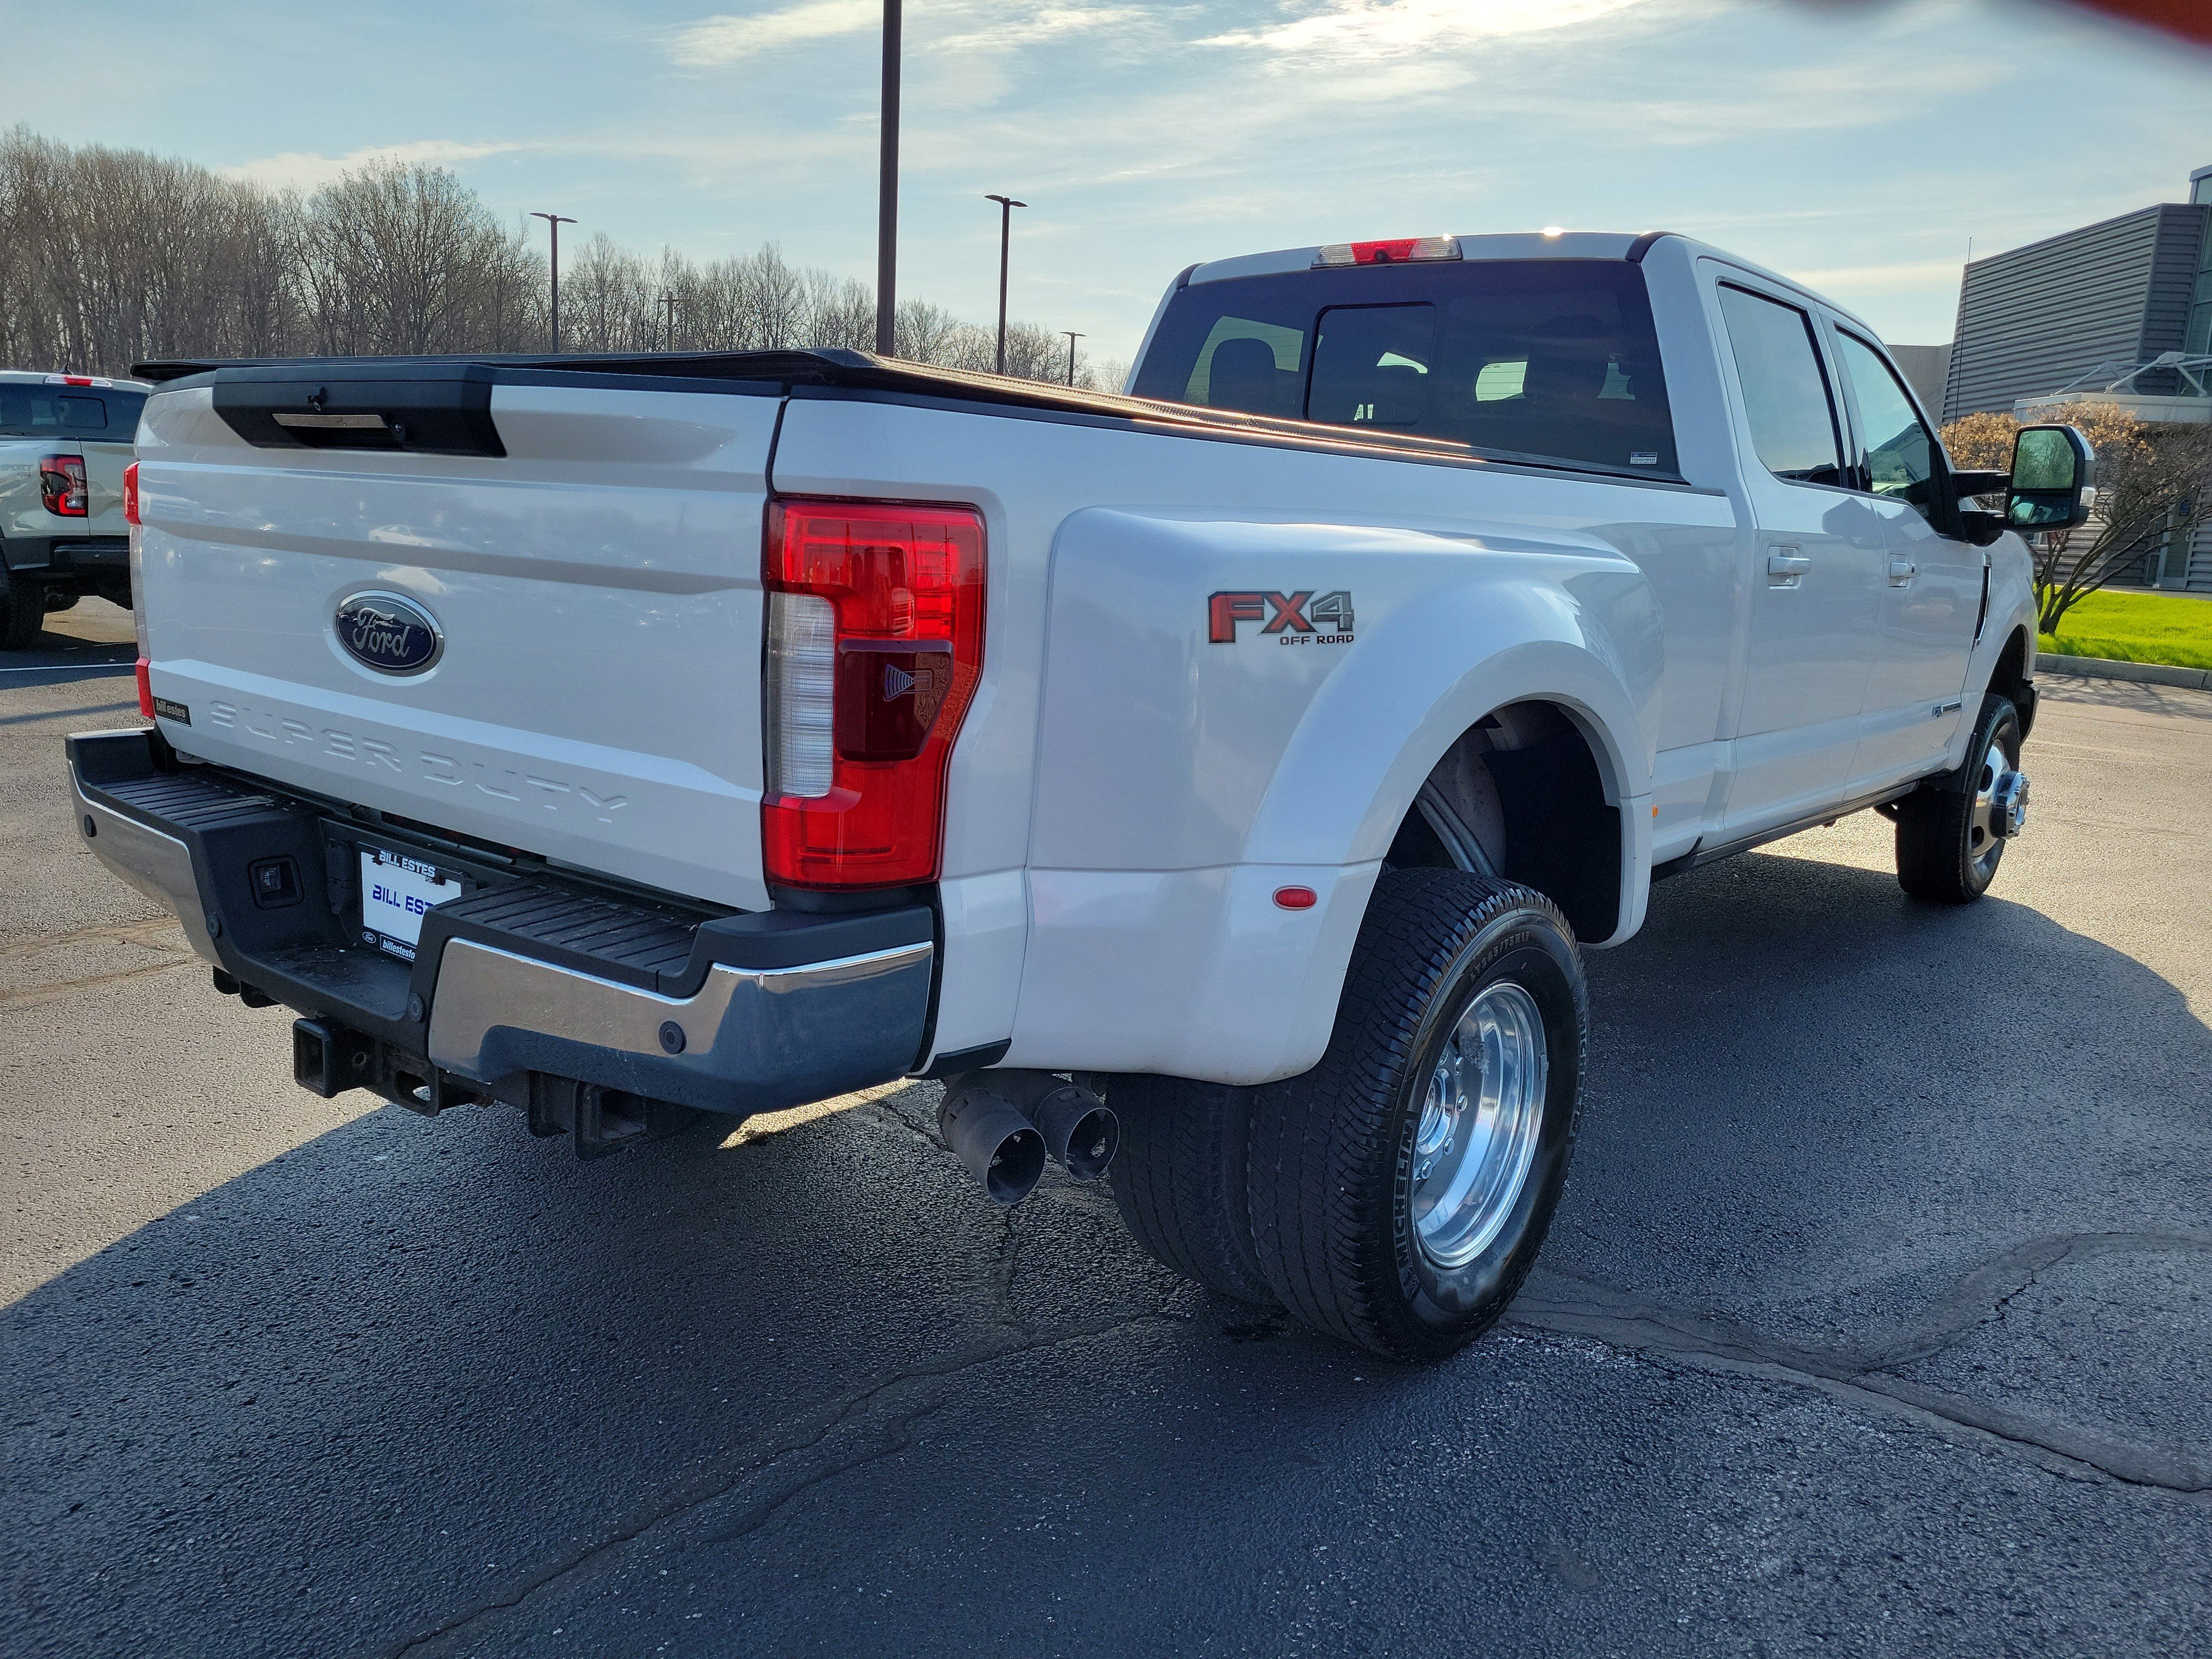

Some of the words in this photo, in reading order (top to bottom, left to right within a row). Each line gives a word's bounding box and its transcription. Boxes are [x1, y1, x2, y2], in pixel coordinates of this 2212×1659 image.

[352, 607, 410, 657] Ford
[1208, 591, 1354, 644] FX4
[1279, 635, 1311, 645] OFF
[1317, 635, 1355, 644] ROAD
[210, 700, 402, 772] SUPER
[420, 751, 627, 823] DUTY
[379, 850, 399, 867] BILL
[402, 857, 436, 878] ESTES
[373, 884, 400, 909] BILL
[1393, 1119, 1414, 1271] MICHELIN
